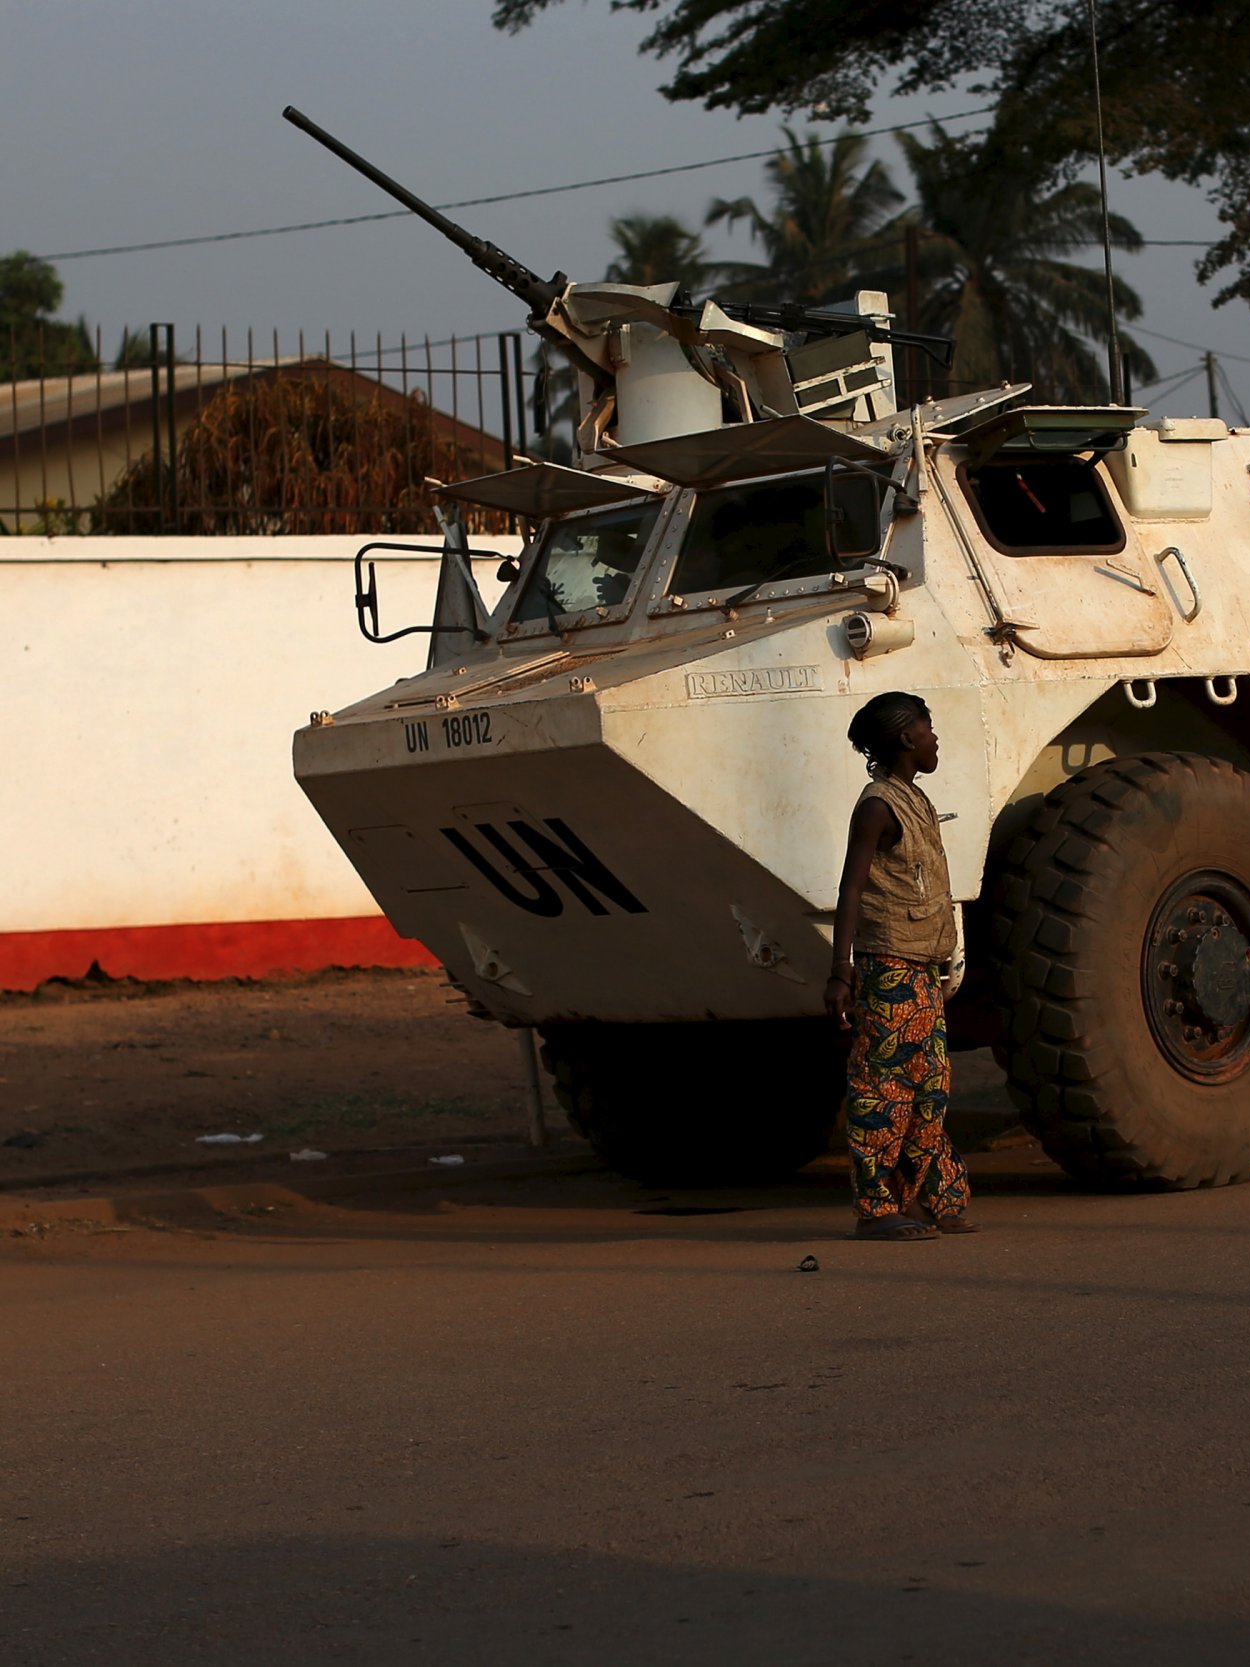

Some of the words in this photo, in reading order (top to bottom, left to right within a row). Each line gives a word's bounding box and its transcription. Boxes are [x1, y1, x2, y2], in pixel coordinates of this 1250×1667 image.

[691, 668, 818, 695] RENAULT
[405, 721, 429, 753] UN
[442, 712, 492, 749] 18012
[439, 818, 650, 917] UN
